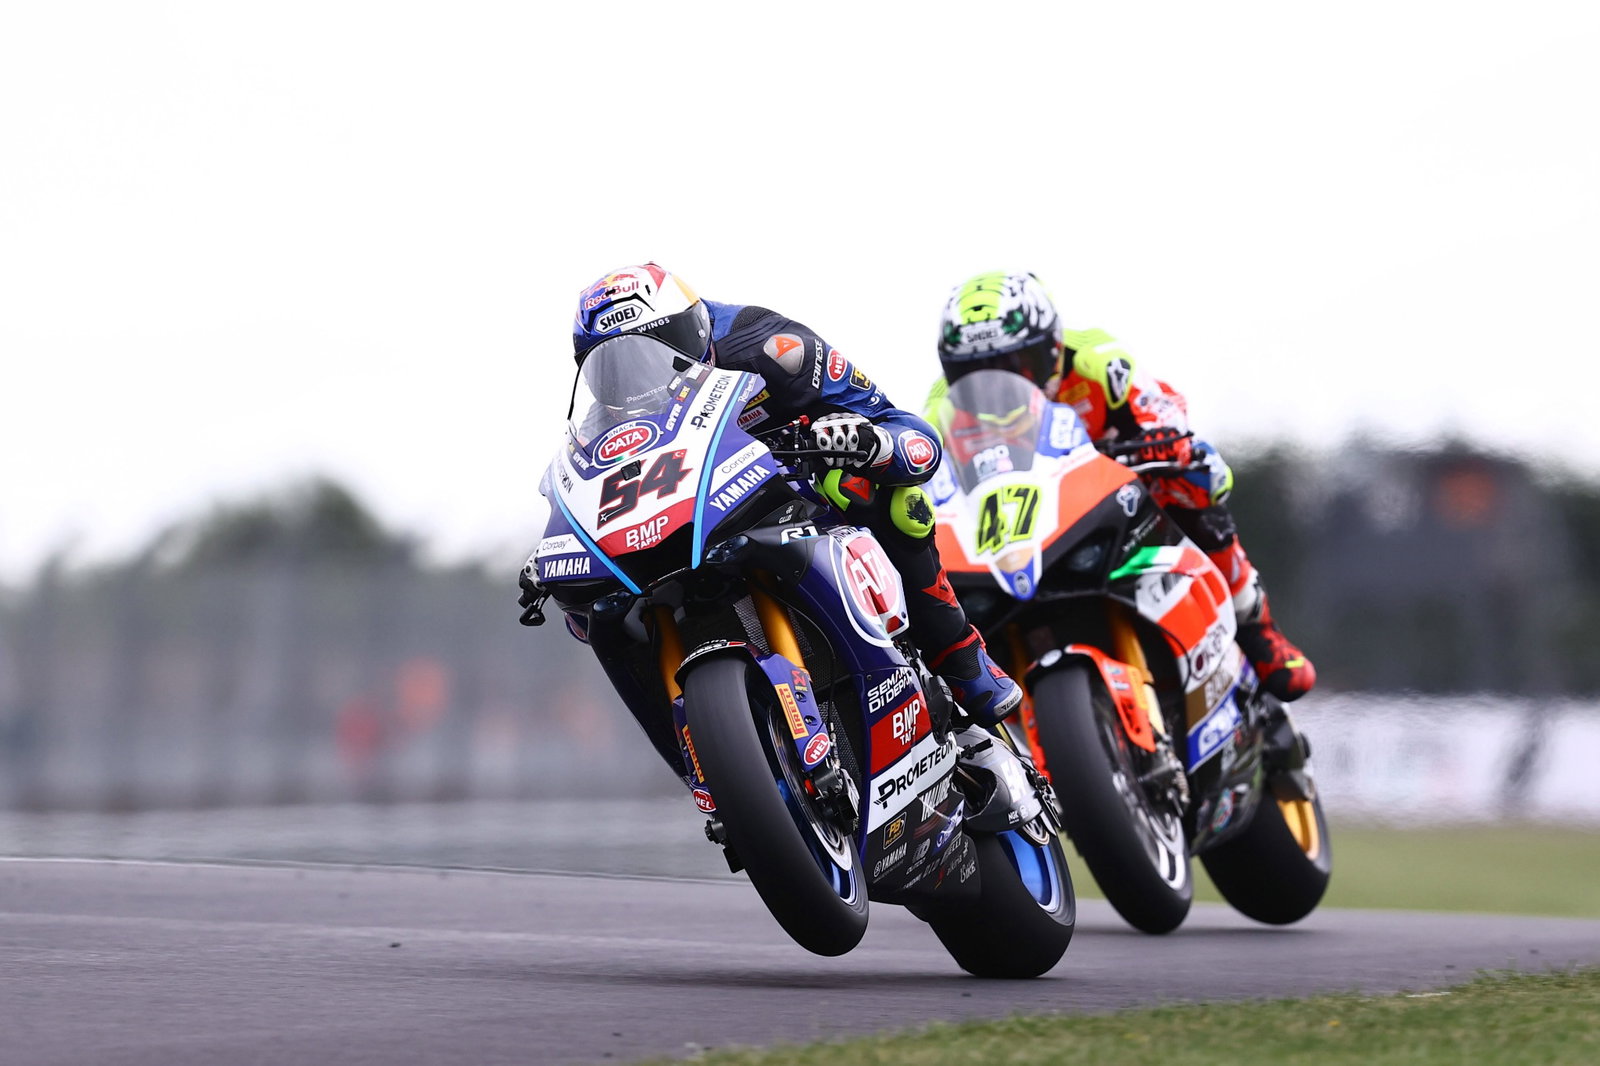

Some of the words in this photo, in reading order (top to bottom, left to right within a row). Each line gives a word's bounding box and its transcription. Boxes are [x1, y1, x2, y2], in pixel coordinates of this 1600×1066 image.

[585, 286, 610, 309] Red
[612, 281, 639, 295] Bull
[600, 306, 637, 331] SHOEI
[637, 317, 670, 334] WINGS
[812, 338, 824, 389] DAINESE
[626, 385, 668, 403] PROMETEON
[691, 374, 732, 431] PROMETEON
[739, 409, 763, 425] AMAHA
[604, 430, 645, 456] PATA
[908, 442, 931, 460] PATA
[721, 449, 756, 474] Corpay
[597, 449, 693, 530] 54
[709, 464, 771, 512] YAMAHA
[625, 515, 669, 548] BMP
[976, 484, 1041, 556] 47
[542, 539, 568, 552] Corpay
[634, 535, 662, 550] TAPPI
[781, 525, 819, 545] R1
[544, 557, 591, 578] YAMAHA
[779, 688, 805, 735] PIRELLI
[892, 698, 921, 739] BMP
[810, 739, 829, 760] HEL
[873, 740, 953, 809] PROMETEON
[695, 796, 713, 809] HEL
[881, 842, 907, 872] YAMAHA
